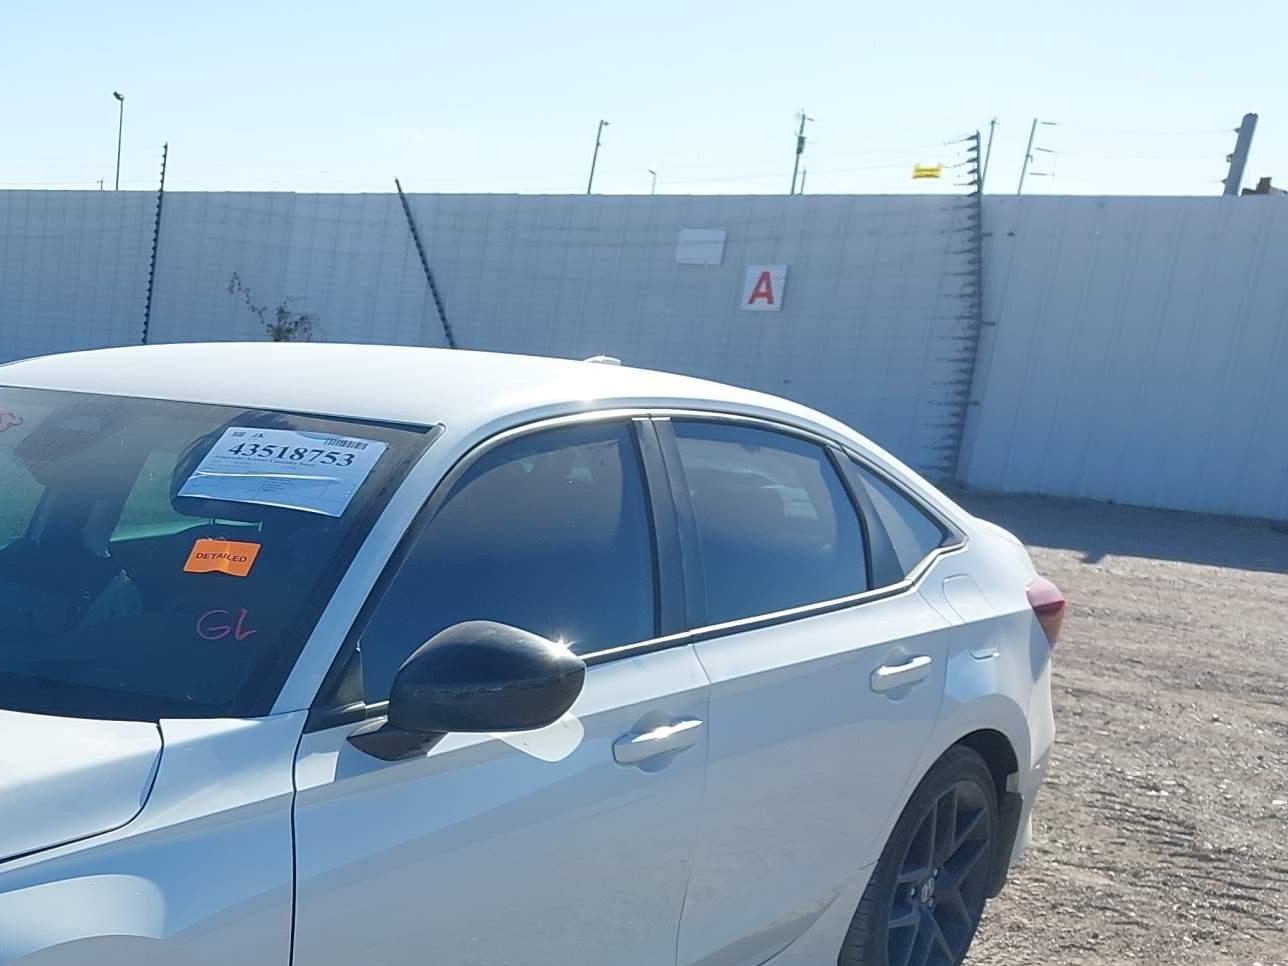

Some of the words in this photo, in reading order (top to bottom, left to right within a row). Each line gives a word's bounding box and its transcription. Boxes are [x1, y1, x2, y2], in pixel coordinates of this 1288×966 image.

[747, 271, 775, 305] A
[228, 442, 356, 467] 43518753
[195, 552, 248, 563] DETAILED
